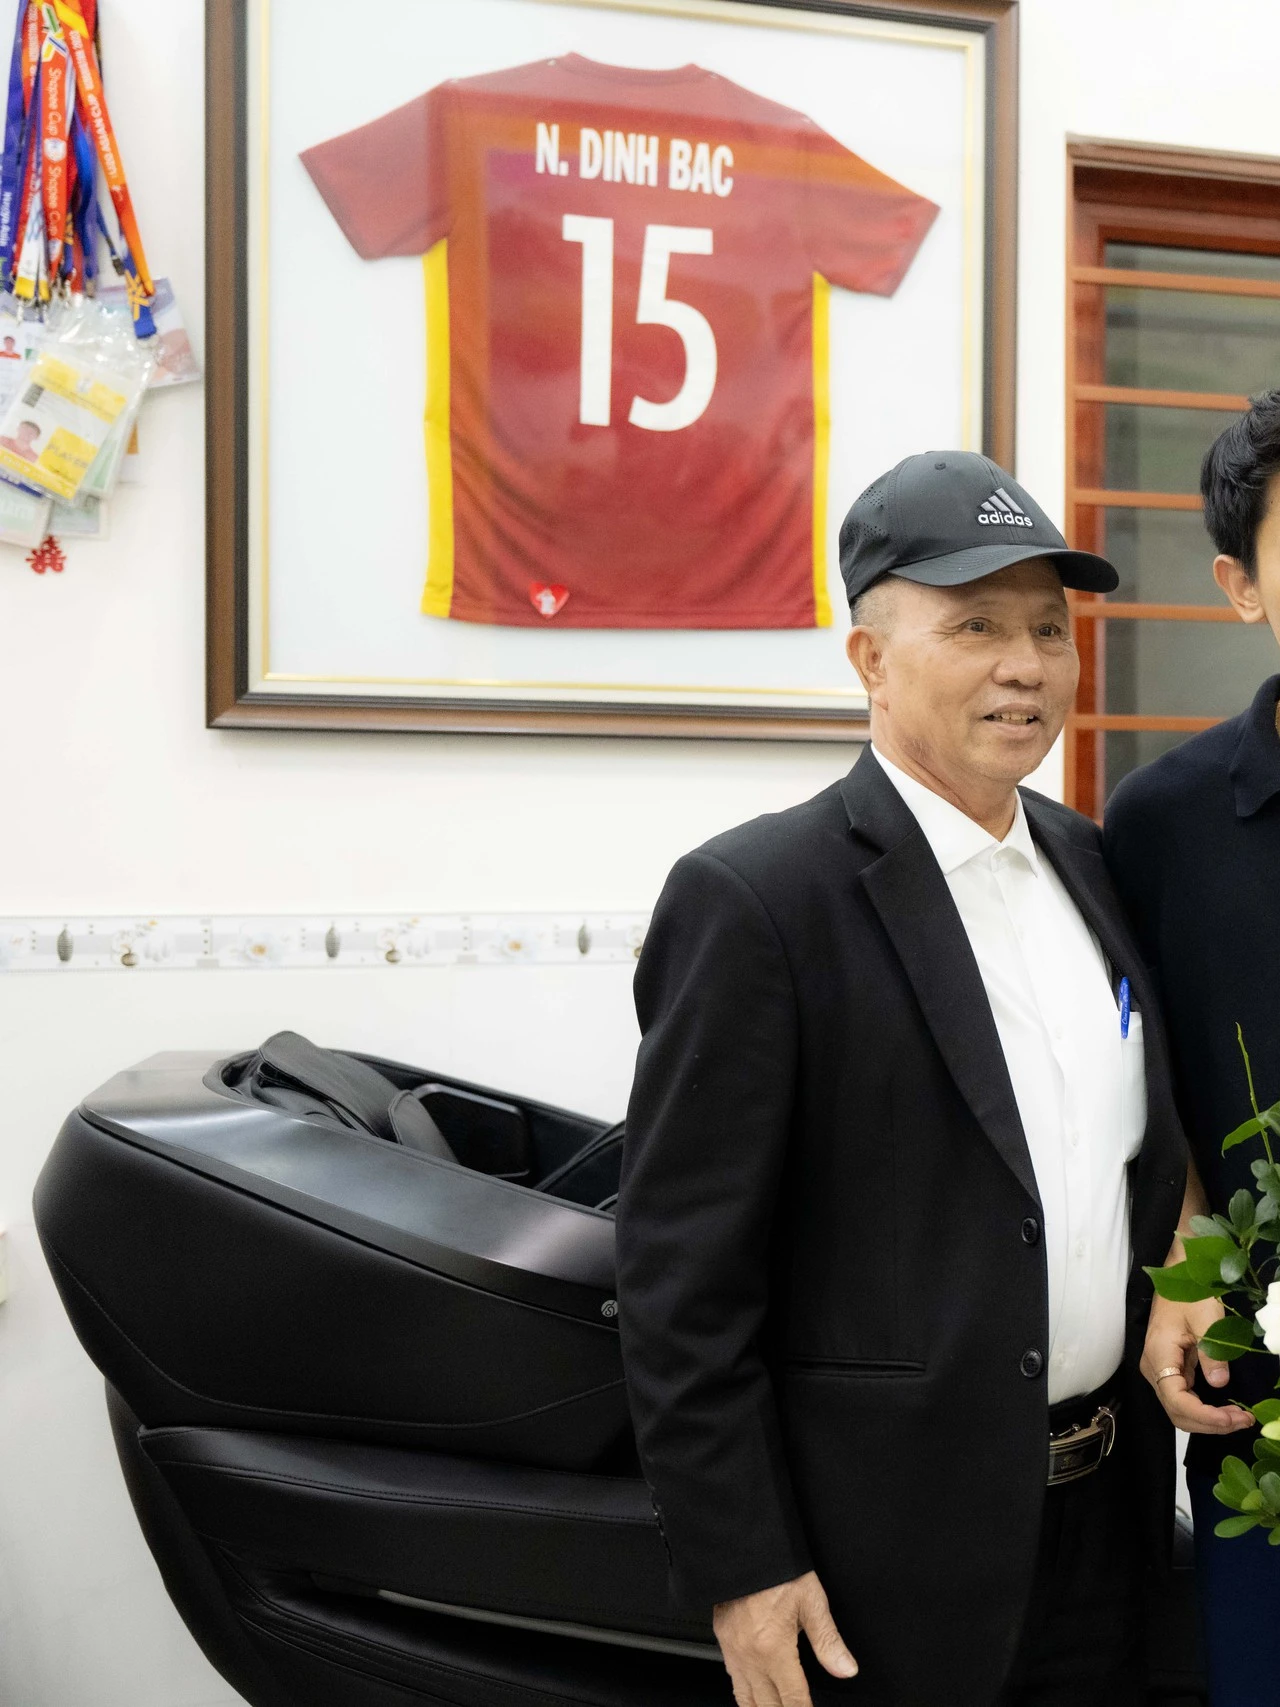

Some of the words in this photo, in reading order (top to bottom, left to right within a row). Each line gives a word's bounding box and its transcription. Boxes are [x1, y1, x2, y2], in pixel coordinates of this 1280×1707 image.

[47, 111, 62, 136] Cup
[536, 122, 568, 176] N.
[580, 127, 659, 187] DINH
[668, 138, 734, 198] BAC
[562, 213, 718, 432] 15
[977, 511, 1033, 527] adidas
